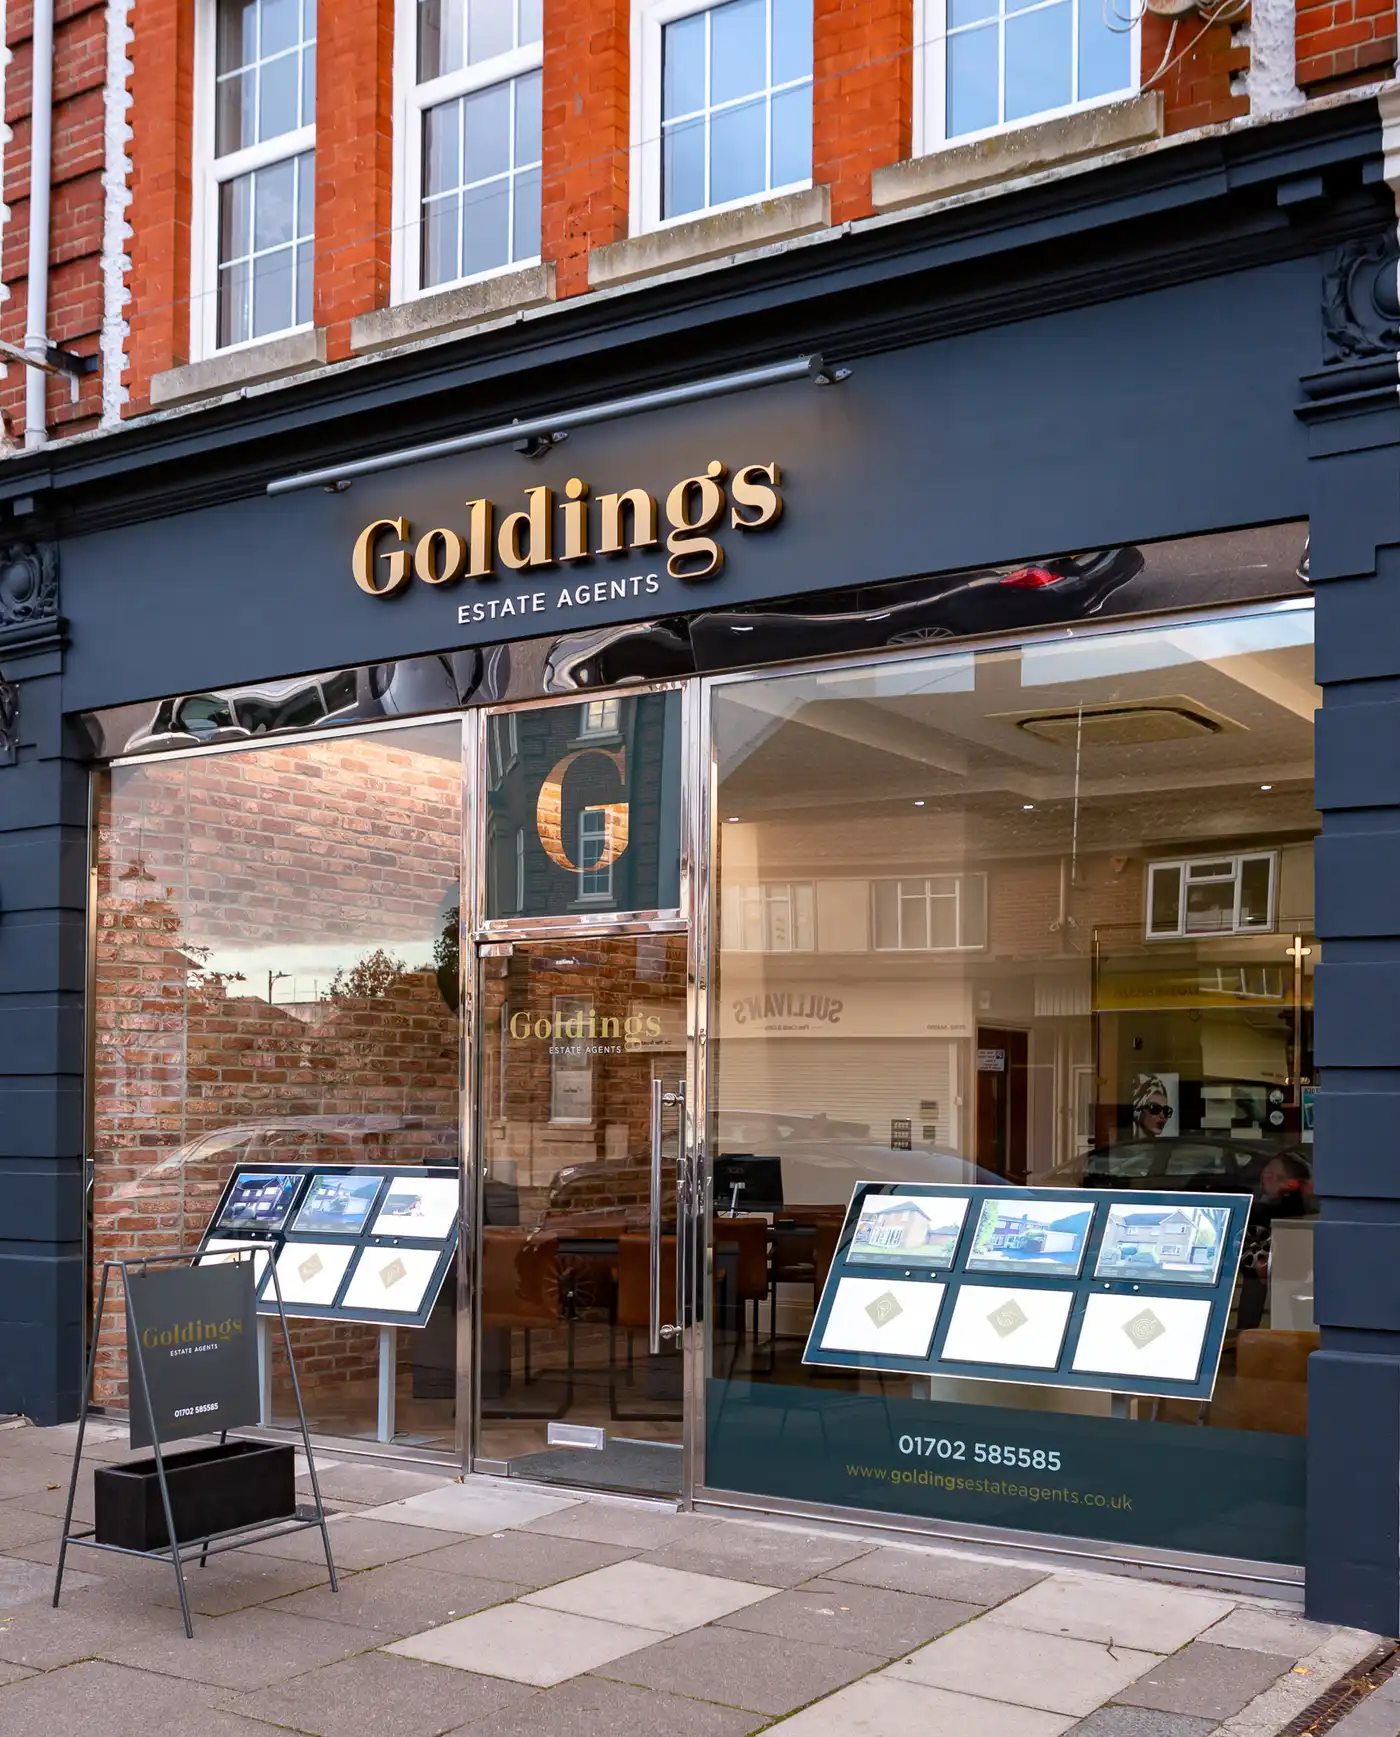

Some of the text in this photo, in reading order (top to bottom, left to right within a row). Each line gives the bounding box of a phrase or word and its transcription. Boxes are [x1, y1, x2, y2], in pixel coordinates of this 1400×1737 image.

[351, 460, 782, 597] Goldings
[457, 574, 660, 624] ESTATE AGENTS
[537, 746, 629, 873] G
[510, 1009, 662, 1051] Goldings
[549, 1045, 621, 1055] ESTATE AGENTS
[142, 1317, 243, 1348] Goldings
[170, 1343, 218, 1357] ESTATE AGENTS
[174, 1402, 219, 1417] 01702 585585
[898, 1434, 1062, 1472] 01702 585585
[845, 1463, 1133, 1512] www.goldingsestateagents.co.uk
